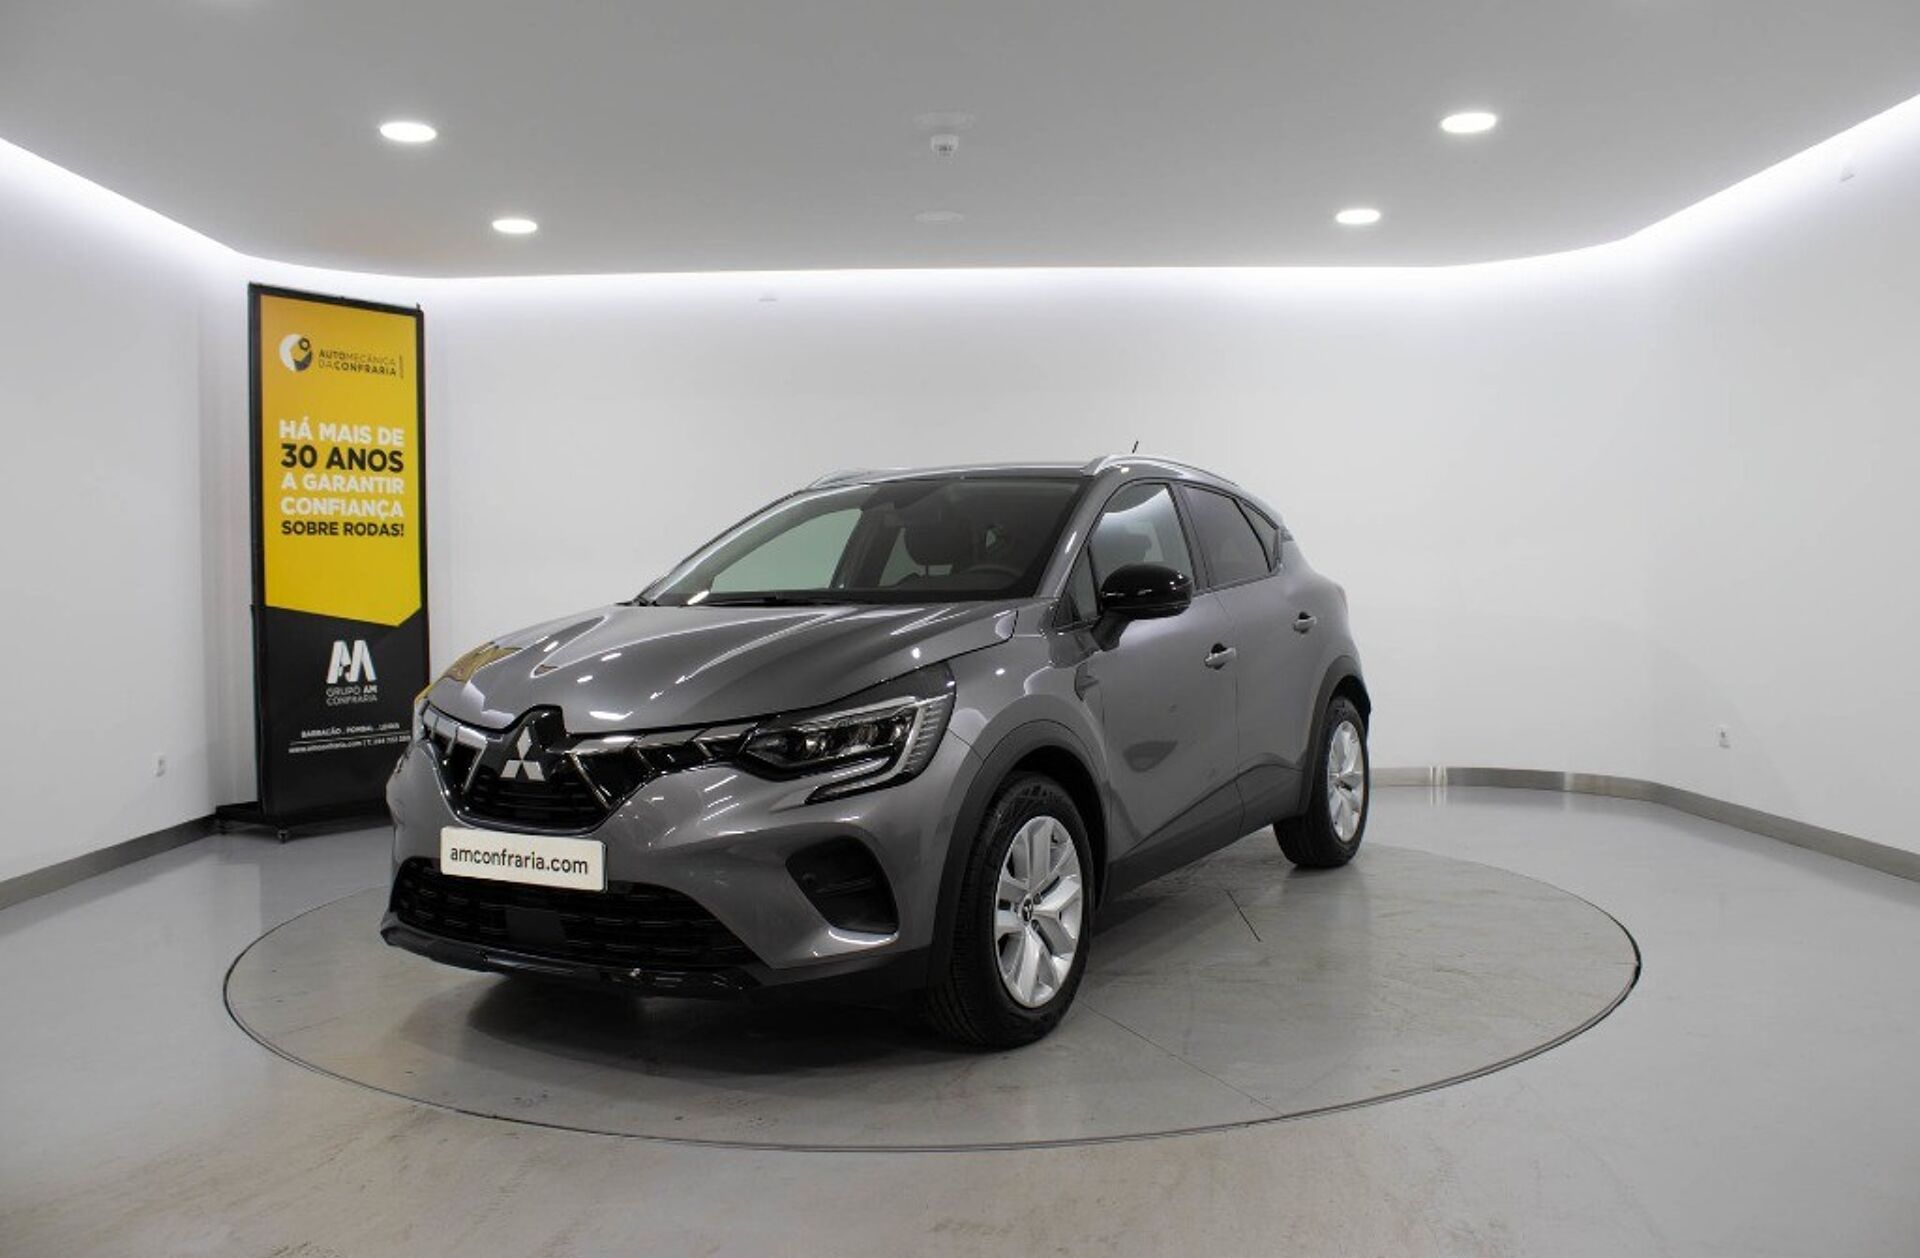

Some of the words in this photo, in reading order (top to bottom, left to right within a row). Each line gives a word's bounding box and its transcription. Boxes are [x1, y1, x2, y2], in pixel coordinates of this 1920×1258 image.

[279, 416, 313, 440] HÁ
[319, 422, 372, 445] MAIS
[377, 426, 404, 447] DE
[281, 443, 318, 469] 30
[325, 446, 404, 473] ANOS
[281, 472, 297, 490] A
[302, 473, 405, 494] GARANTIR
[280, 496, 404, 520] CONFIANÇA
[281, 520, 339, 536] SOBRE
[343, 522, 405, 537] RODAS!
[326, 686, 361, 697] GRUPO
[363, 684, 378, 694] AM
[326, 694, 378, 706] CONFRARIA
[450, 847, 588, 875] amconfraria.com
